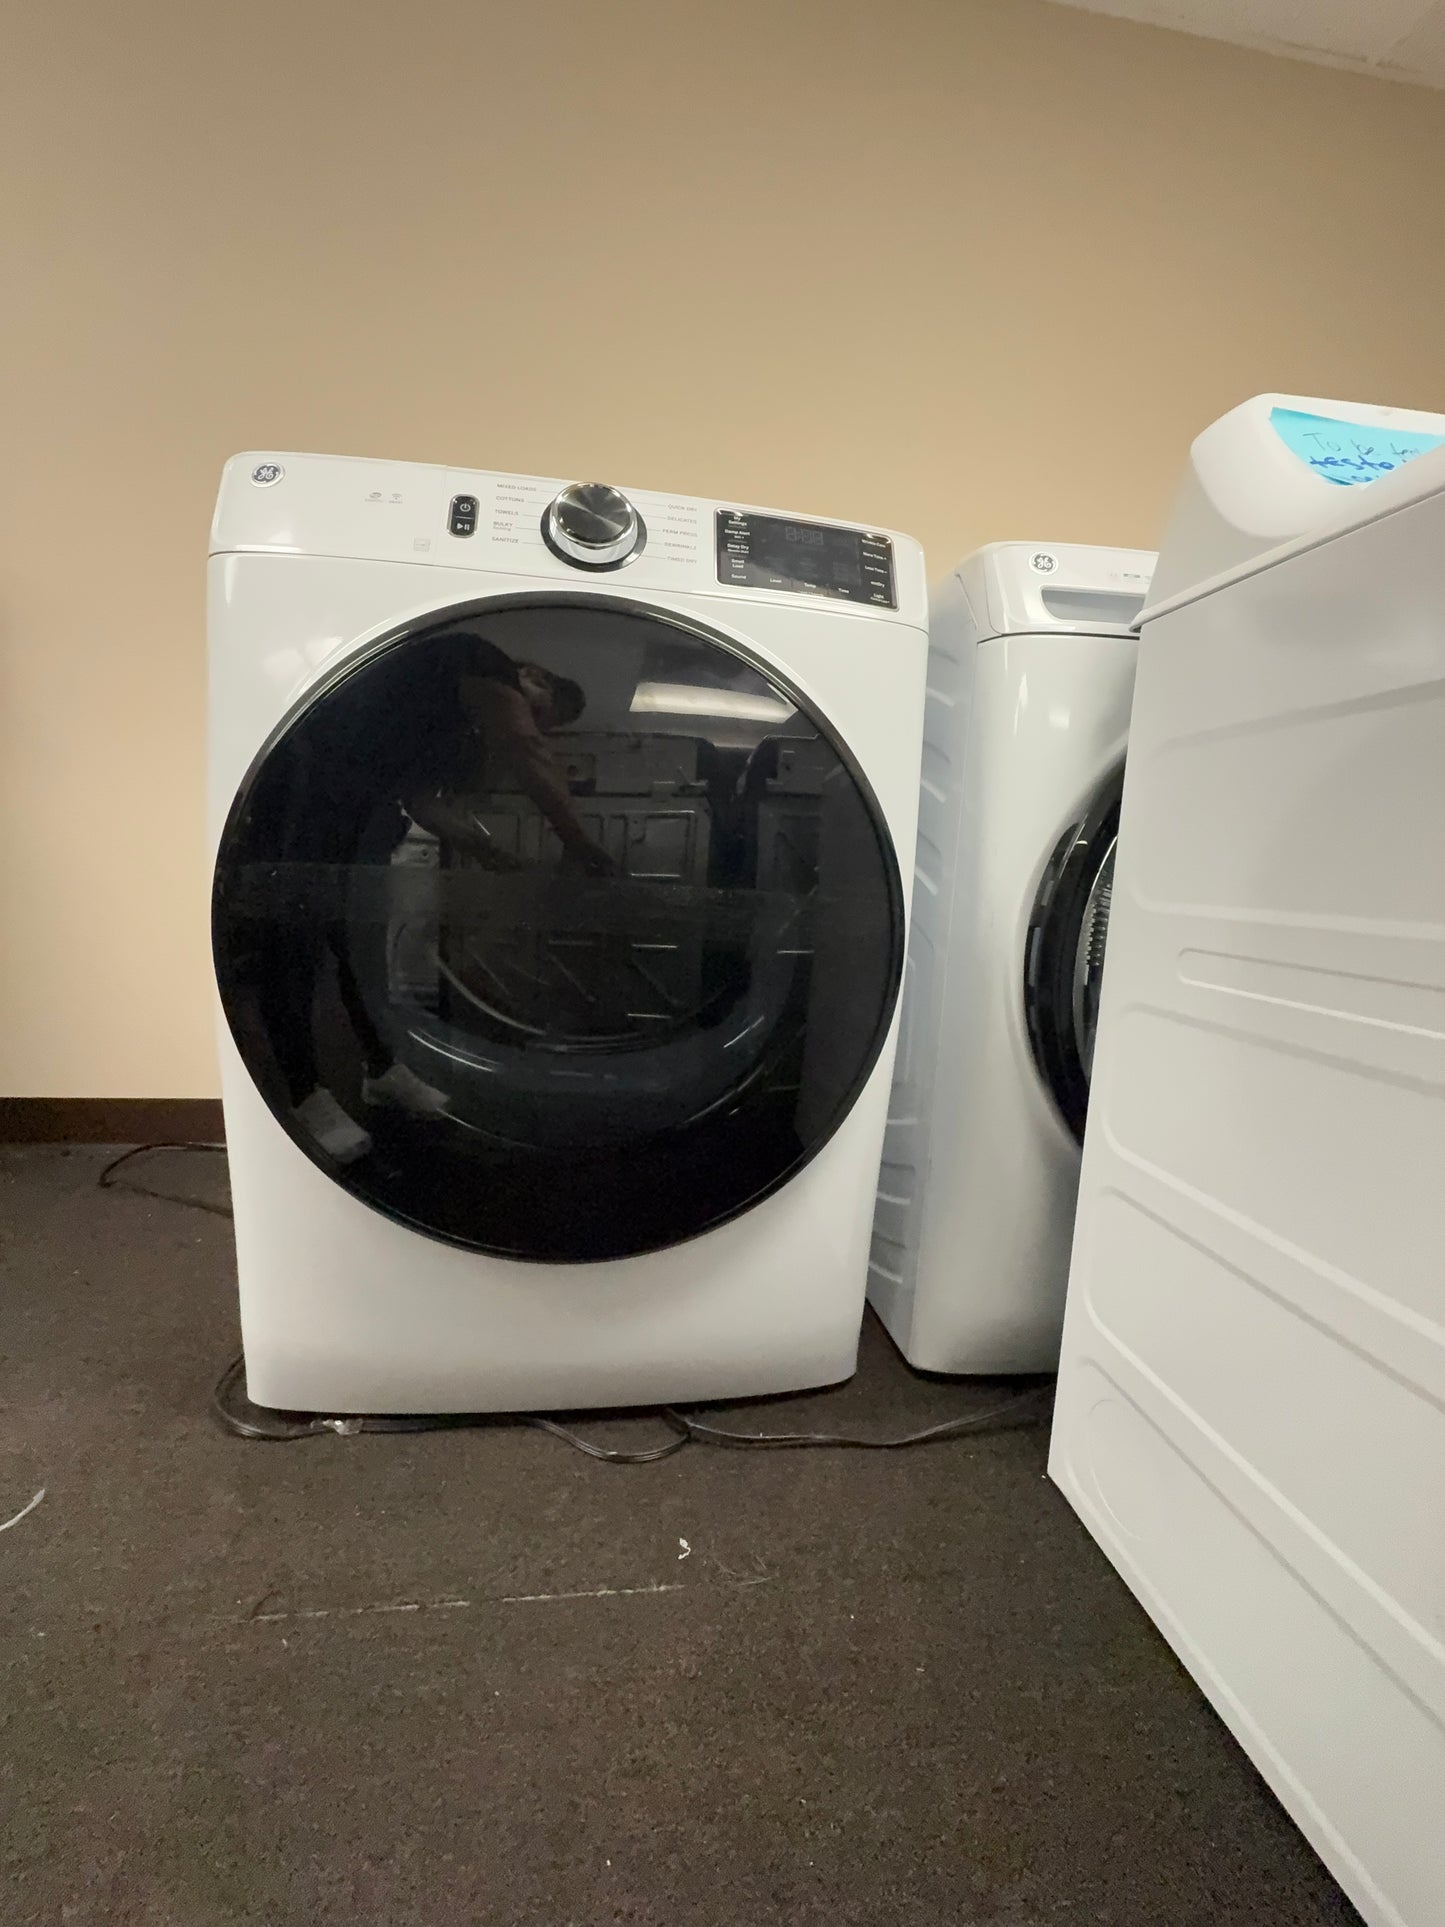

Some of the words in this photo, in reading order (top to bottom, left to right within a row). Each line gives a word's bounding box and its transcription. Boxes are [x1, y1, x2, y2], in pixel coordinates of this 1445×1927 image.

[495, 495, 525, 503] COTTONS
[667, 503, 685, 511] QUICK
[667, 516, 698, 525] DELICATES
[491, 536, 519, 544] SANITIZE
